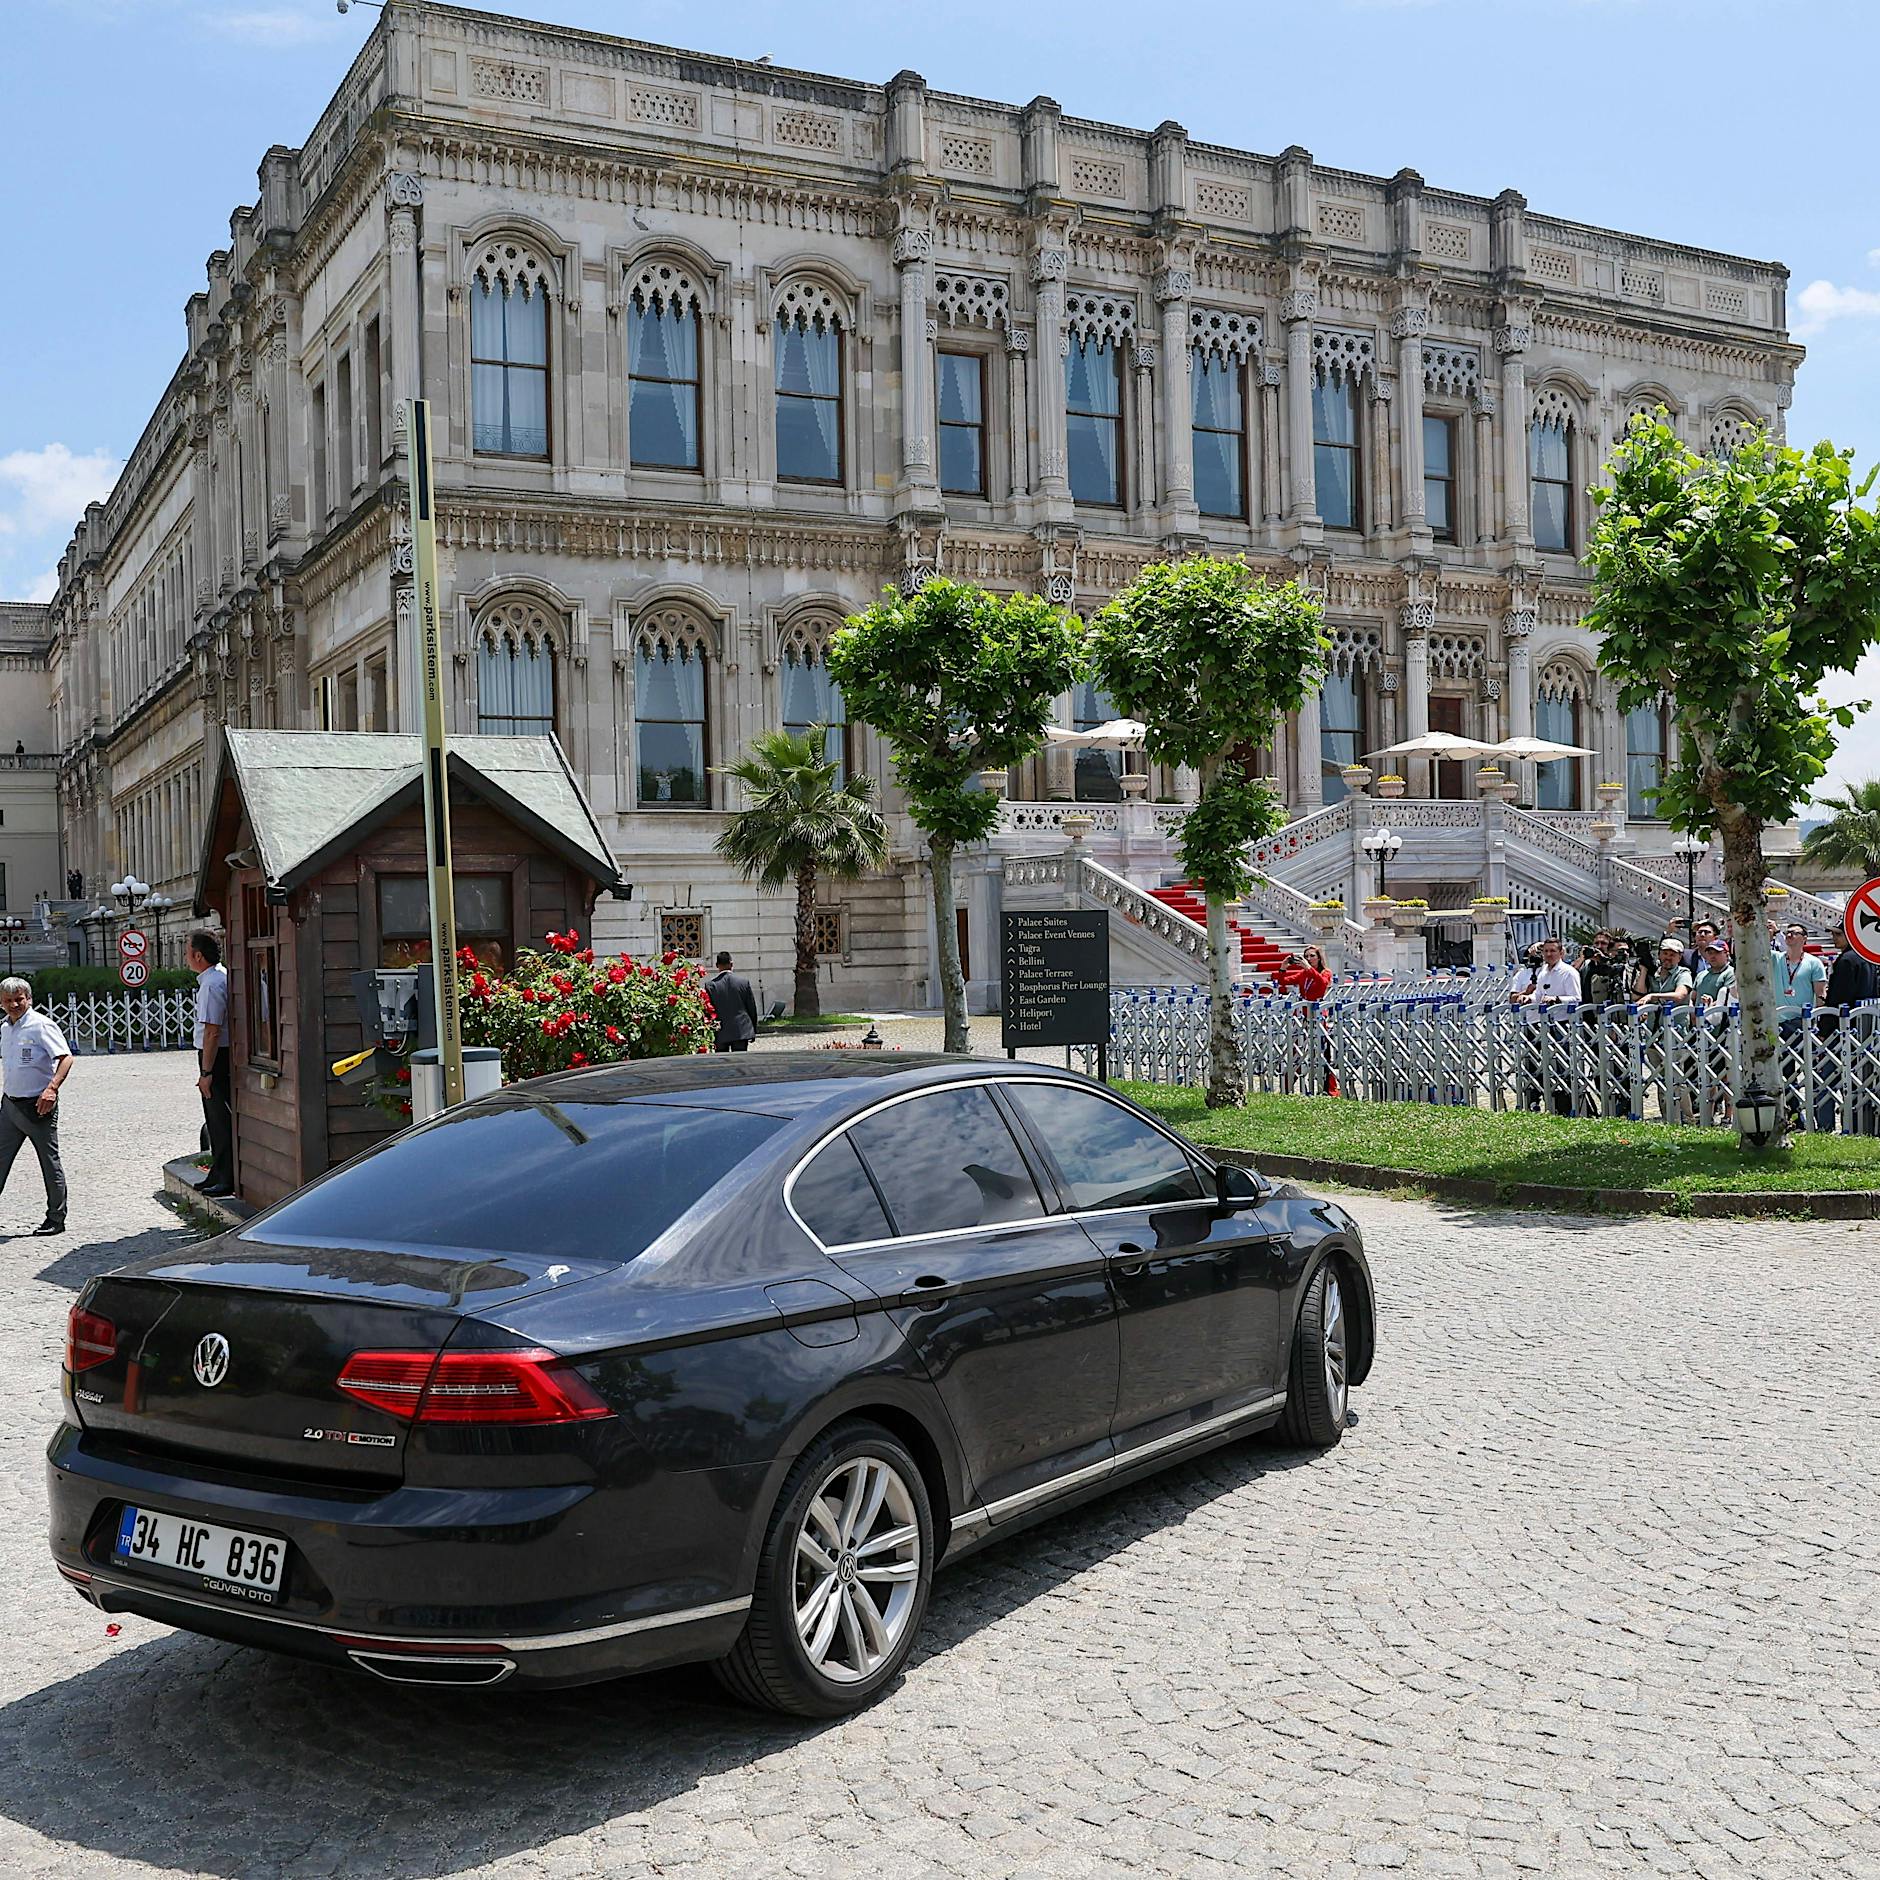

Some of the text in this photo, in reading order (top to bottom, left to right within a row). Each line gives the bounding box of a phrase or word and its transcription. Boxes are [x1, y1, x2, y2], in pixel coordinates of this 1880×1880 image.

[424, 581, 437, 700] www.parksistem.com
[1018, 917, 1068, 927] Palace Suites
[1018, 930, 1095, 940] Palace Event Venues
[1018, 957, 1045, 966] Bellini
[126, 966, 144, 979] 20
[1019, 969, 1073, 978] Palace Terrace
[441, 922, 454, 1041] www.parksistem.com
[1019, 981, 1107, 994] Bosphorus Pier Lounge
[1020, 995, 1066, 1004] East Garden
[1020, 1009, 1053, 1019] Heliport
[1020, 1022, 1042, 1030] Hotel
[304, 1428, 324, 1439] 2.0
[324, 1430, 347, 1441] TDI
[121, 1534, 132, 1548] TR
[132, 1515, 279, 1585] 34 HC 836
[209, 1580, 272, 1602] GÜVEN OTO
